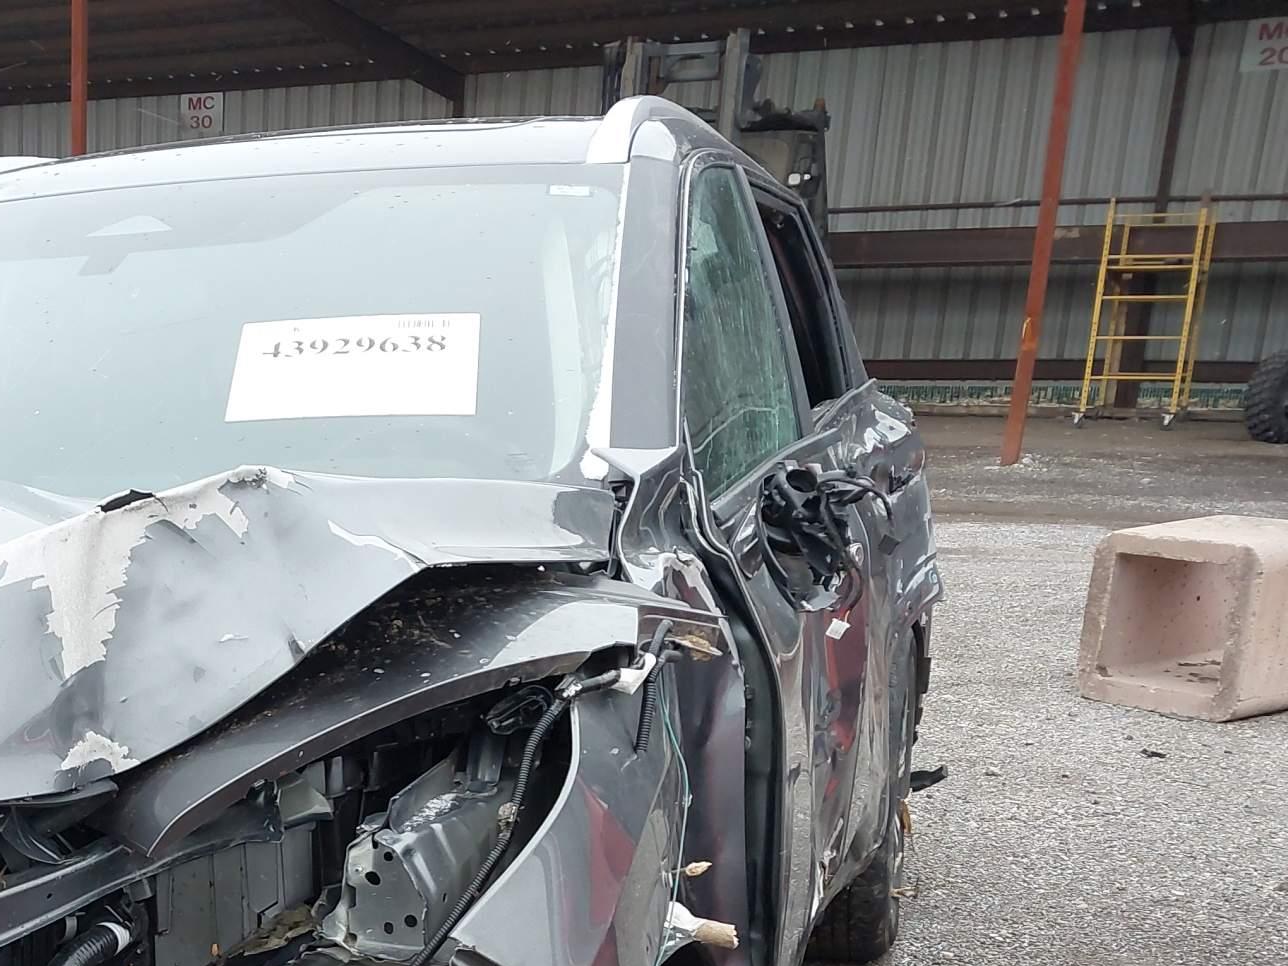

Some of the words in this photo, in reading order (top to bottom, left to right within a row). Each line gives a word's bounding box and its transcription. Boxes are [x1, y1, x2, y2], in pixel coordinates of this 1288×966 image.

[1258, 22, 1288, 40] M
[188, 96, 215, 110] MC
[190, 115, 212, 129] 30
[262, 335, 446, 358] 43929638
